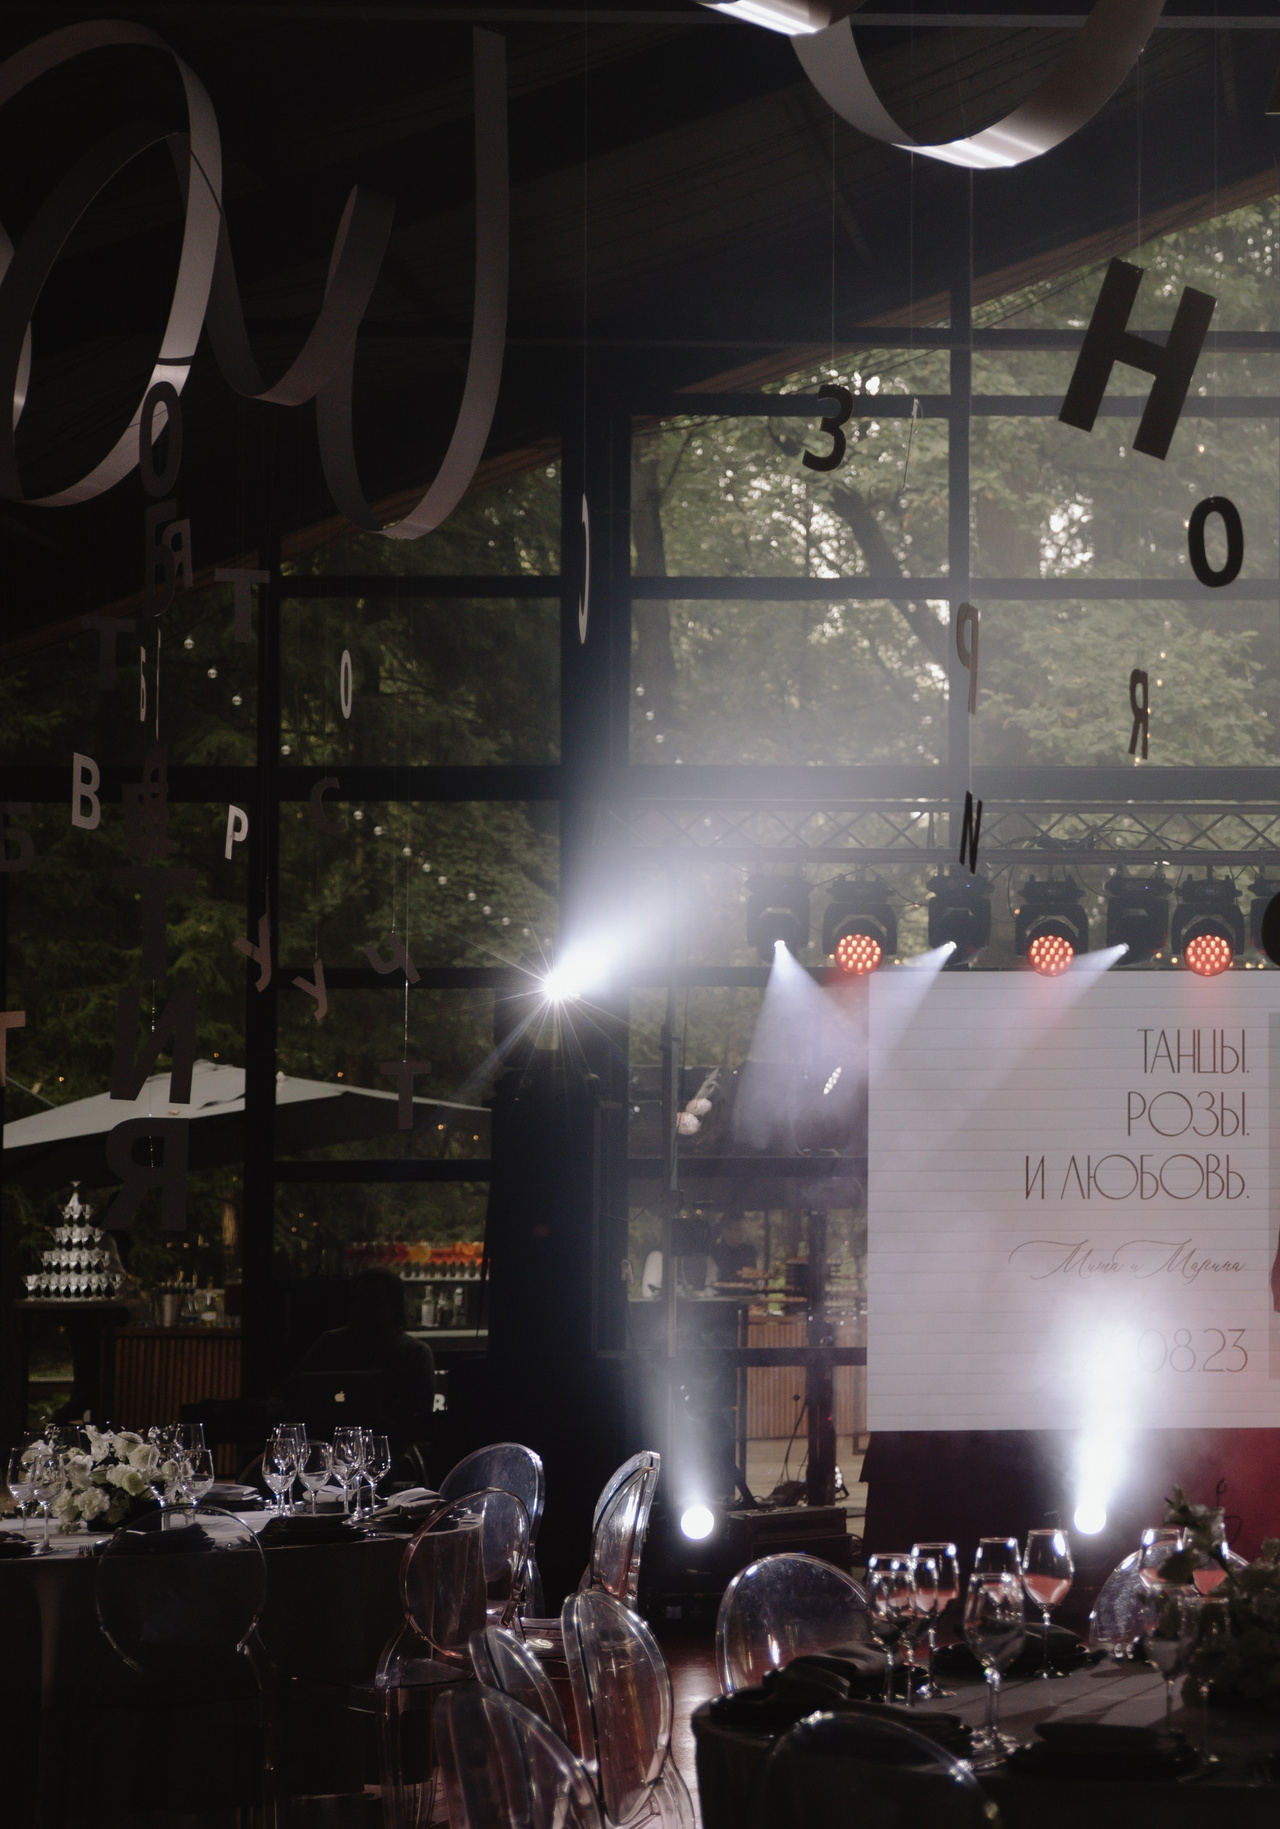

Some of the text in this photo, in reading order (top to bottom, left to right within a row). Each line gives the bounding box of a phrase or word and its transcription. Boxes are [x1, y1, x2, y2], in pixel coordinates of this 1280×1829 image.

[1127, 1091, 1250, 1137] РОЗЫ.
[1025, 1154, 1250, 1200] И ЛЮБОВЬ.
